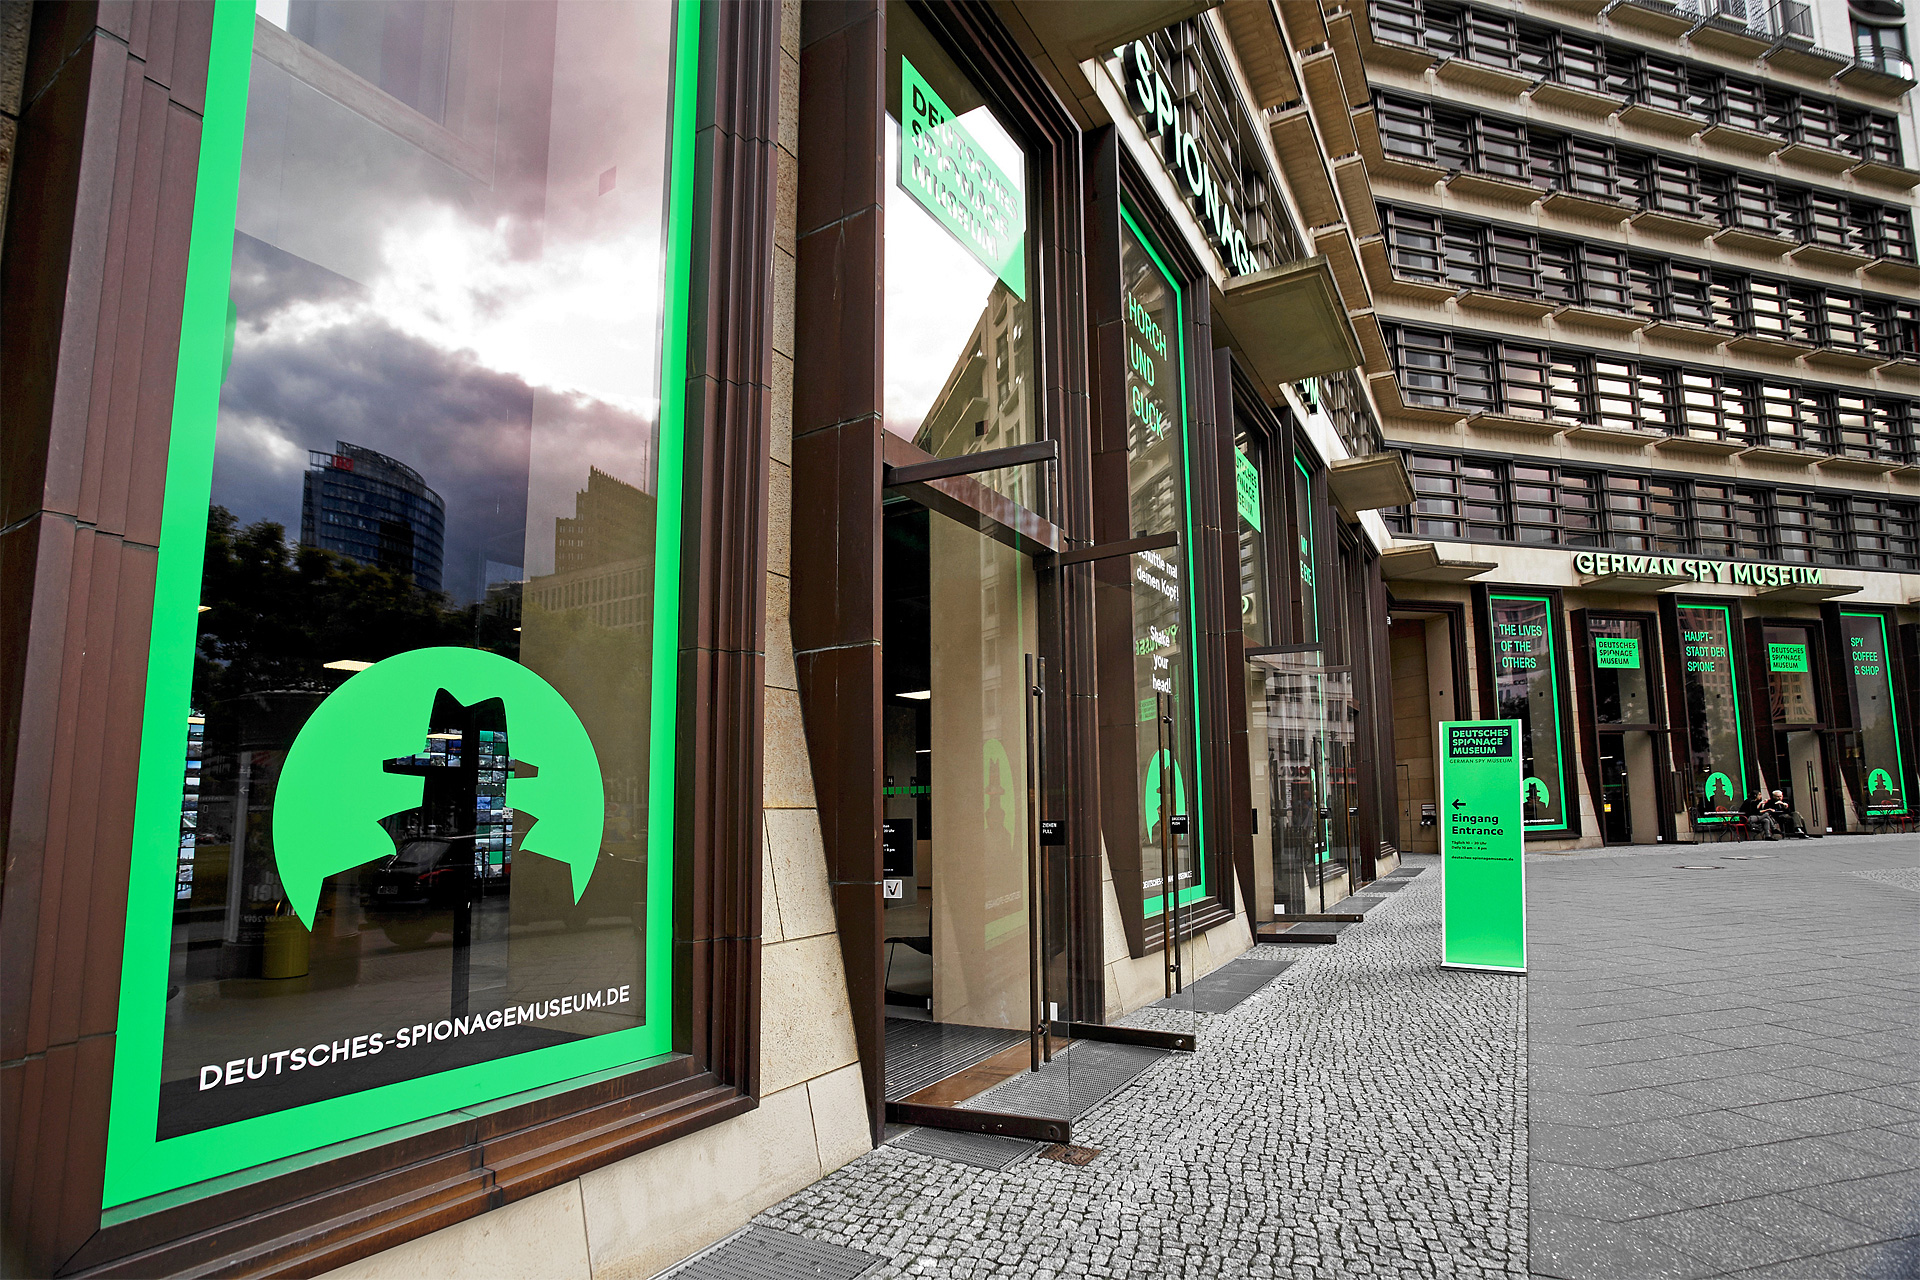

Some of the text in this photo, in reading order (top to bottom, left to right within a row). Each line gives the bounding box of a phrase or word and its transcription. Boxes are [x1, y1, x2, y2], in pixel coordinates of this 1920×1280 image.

[911, 83, 1019, 221] DEUTSCHES
[911, 119, 1010, 242] SPIONAGE
[911, 154, 999, 262] MUSEUM
[1128, 291, 1168, 362] HORCH
[1130, 336, 1155, 387] UND
[1132, 385, 1164, 441] GUCK
[1166, 562, 1178, 580] mal
[1576, 551, 1823, 586] GERMAN SPY MUSEUM
[1136, 564, 1180, 602] deinen Kopf!
[1149, 625, 1171, 648] Shake
[1499, 623, 1543, 637] THE LIVES
[1684, 631, 1714, 642] HAUPT-
[1500, 640, 1532, 653] OF THE
[1598, 641, 1636, 649] DEUTSCHES
[1850, 637, 1864, 647] SPY
[1599, 649, 1633, 657] SPIONAGE
[1685, 646, 1726, 658] STADT DER
[1771, 646, 1804, 654] DEUTSCHES
[1852, 651, 1878, 662] COFFEE
[1153, 653, 1169, 671] your
[1501, 656, 1537, 669] OTHERS
[1600, 657, 1630, 665] MUSEUM
[1771, 654, 1802, 662] SPIONAGE
[1687, 661, 1716, 672] SPIONE
[1854, 665, 1880, 676] & SHOP
[1152, 673, 1172, 694] head!
[1452, 728, 1509, 738] DEUTSCHES
[1452, 737, 1504, 746] SPIONAGE
[1452, 746, 1497, 755] MUSEUM
[1451, 812, 1499, 825] Eingang
[1451, 826, 1504, 836] Entrance
[198, 984, 631, 1092] DEUTSCHES-SPIONAGEMUSEUM.DE
